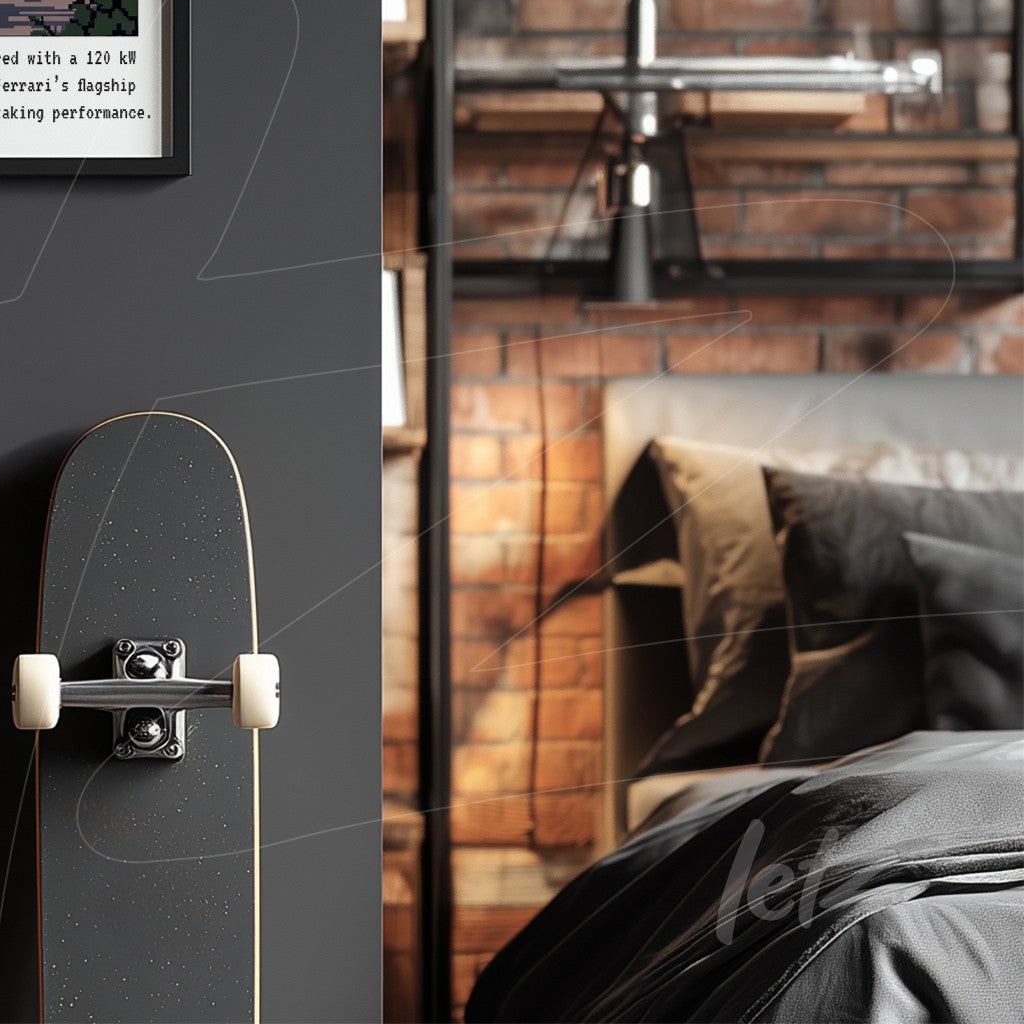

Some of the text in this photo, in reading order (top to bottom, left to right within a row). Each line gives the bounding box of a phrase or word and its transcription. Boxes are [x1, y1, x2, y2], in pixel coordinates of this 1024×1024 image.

[27, 50, 61, 65] with
[69, 54, 78, 65] a
[86, 50, 111, 65] 120
[119, 50, 137, 65] kW
[77, 78, 137, 96] flagship
[52, 105, 152, 123] performance.
